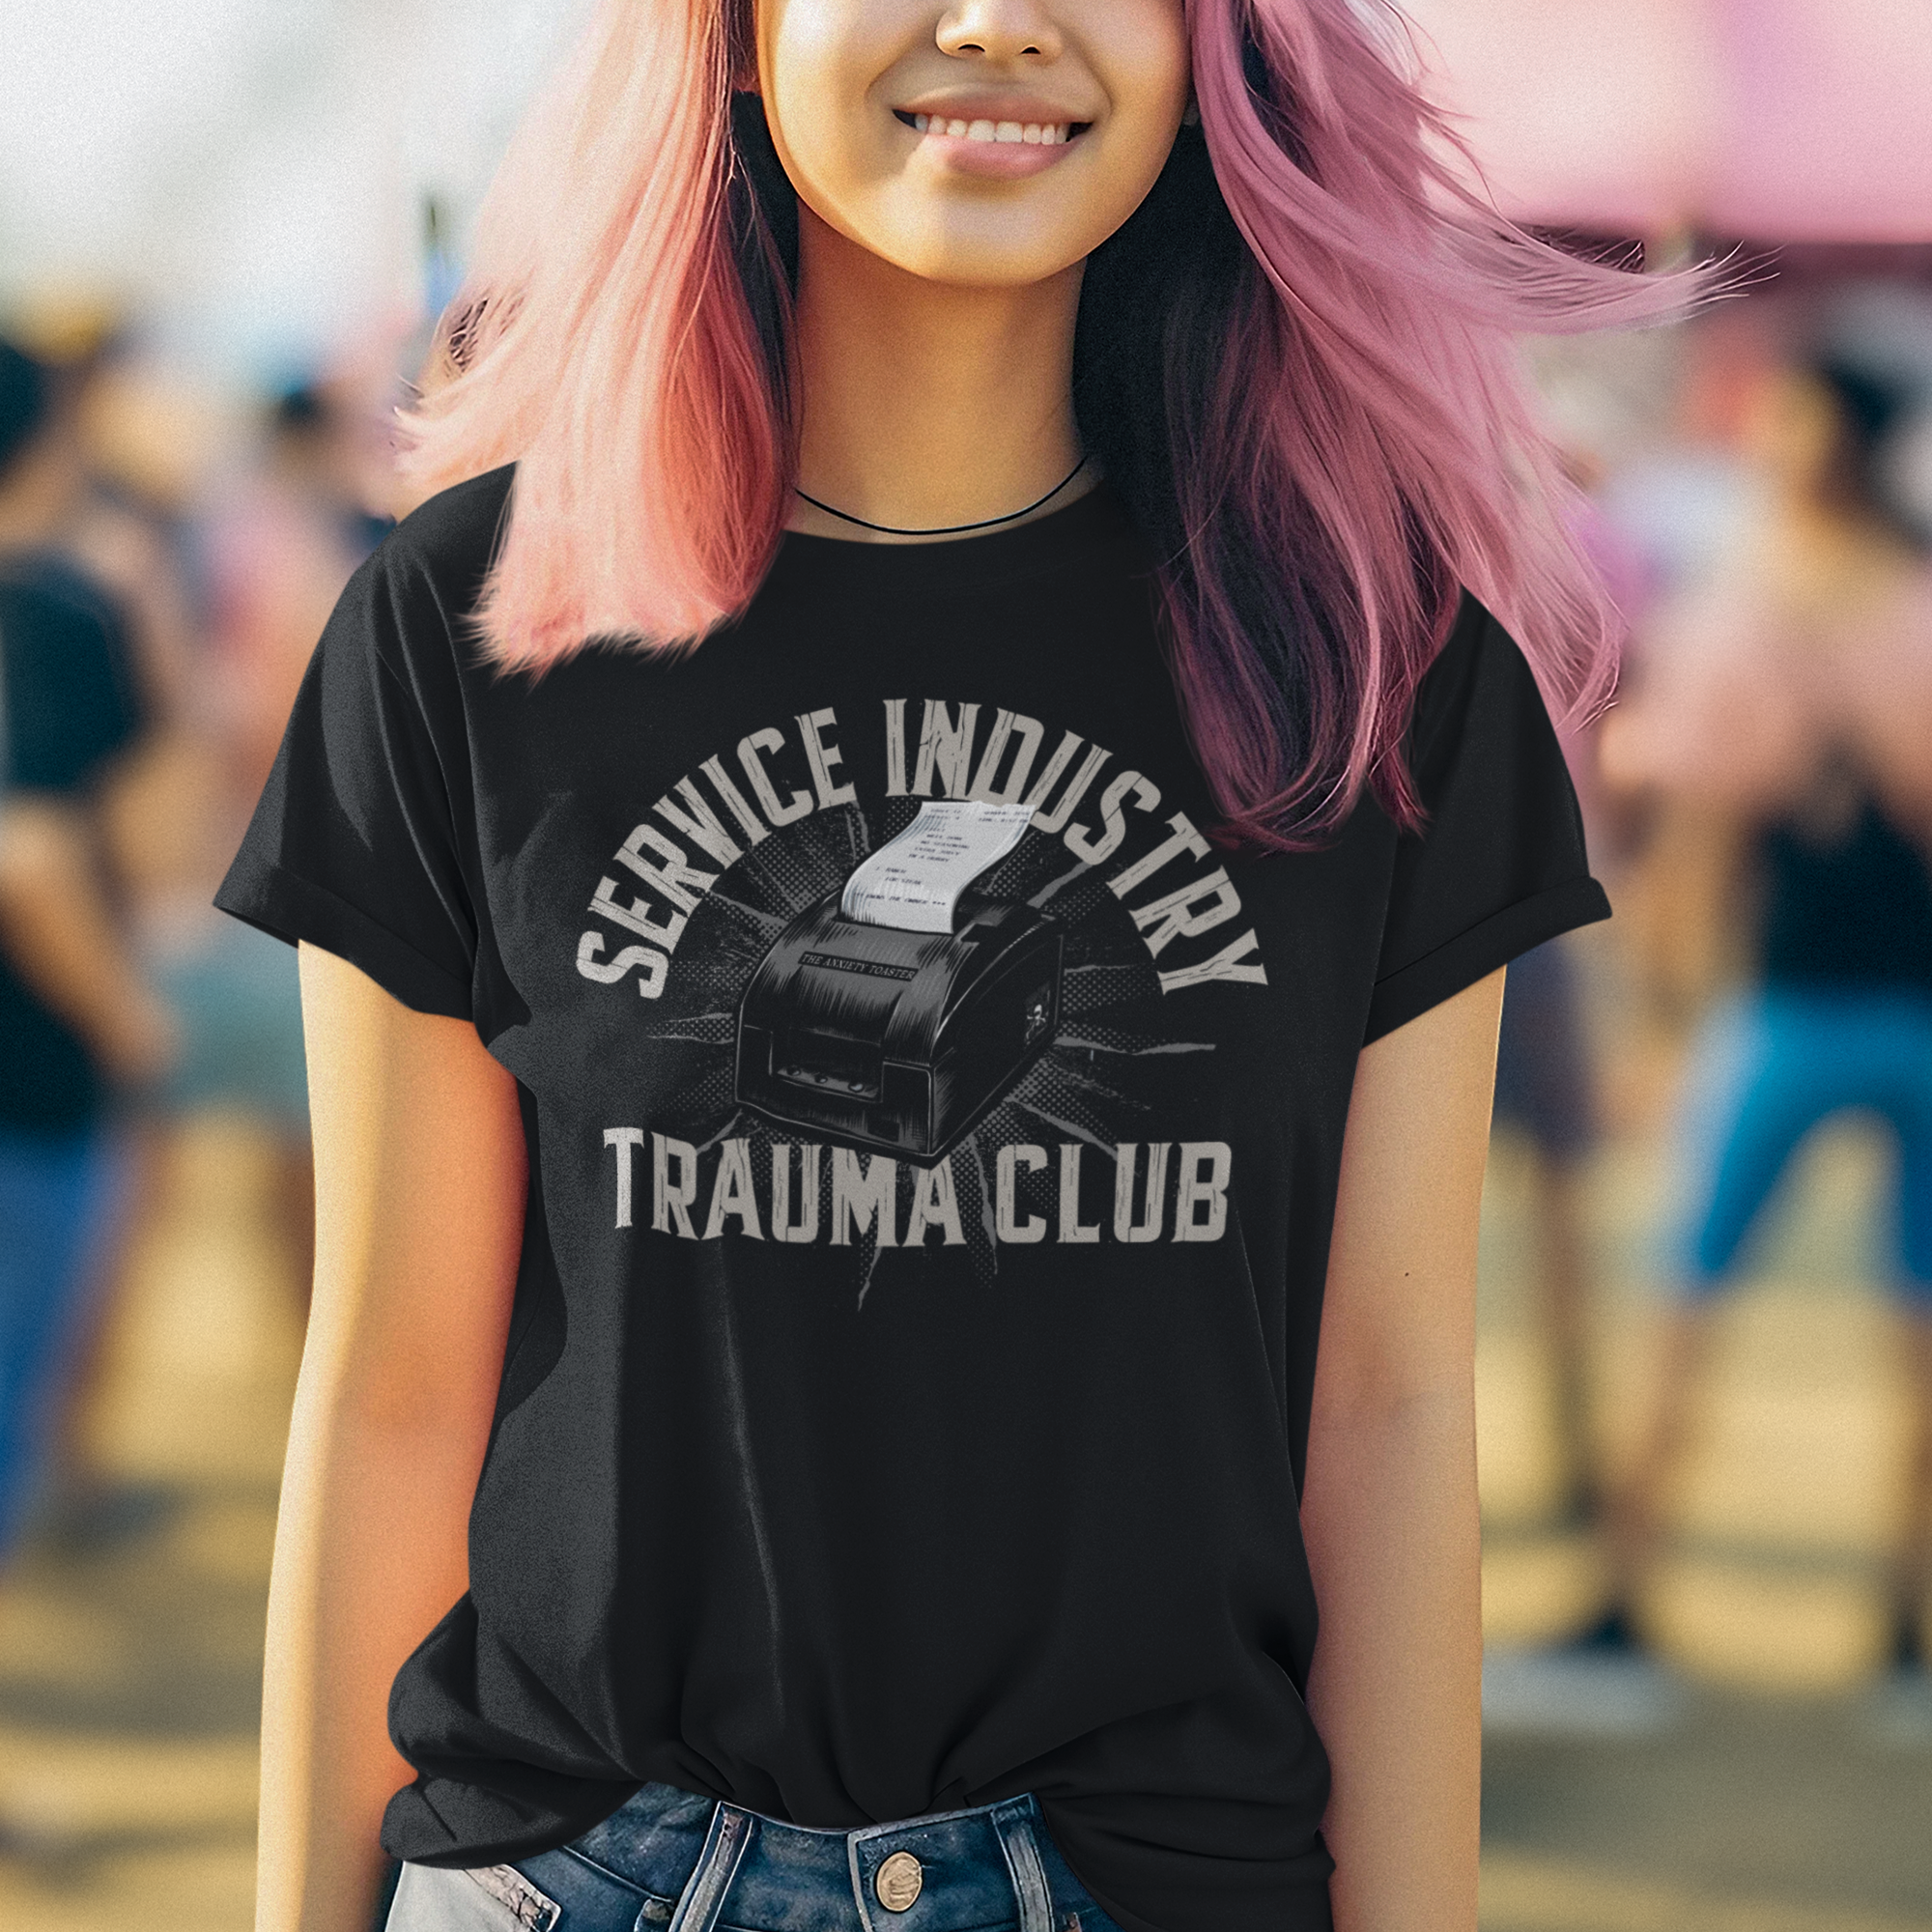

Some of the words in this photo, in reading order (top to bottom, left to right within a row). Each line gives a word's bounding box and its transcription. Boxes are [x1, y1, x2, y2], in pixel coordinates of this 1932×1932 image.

[576, 707, 857, 999] SERVICE
[884, 698, 1267, 995] INDUSTRY
[801, 953, 823, 965] THE
[823, 956, 868, 973] ANXIETY
[868, 965, 916, 980] TOASTER
[603, 1126, 966, 1247] TRAUMA
[995, 1141, 1232, 1243] CLUB
